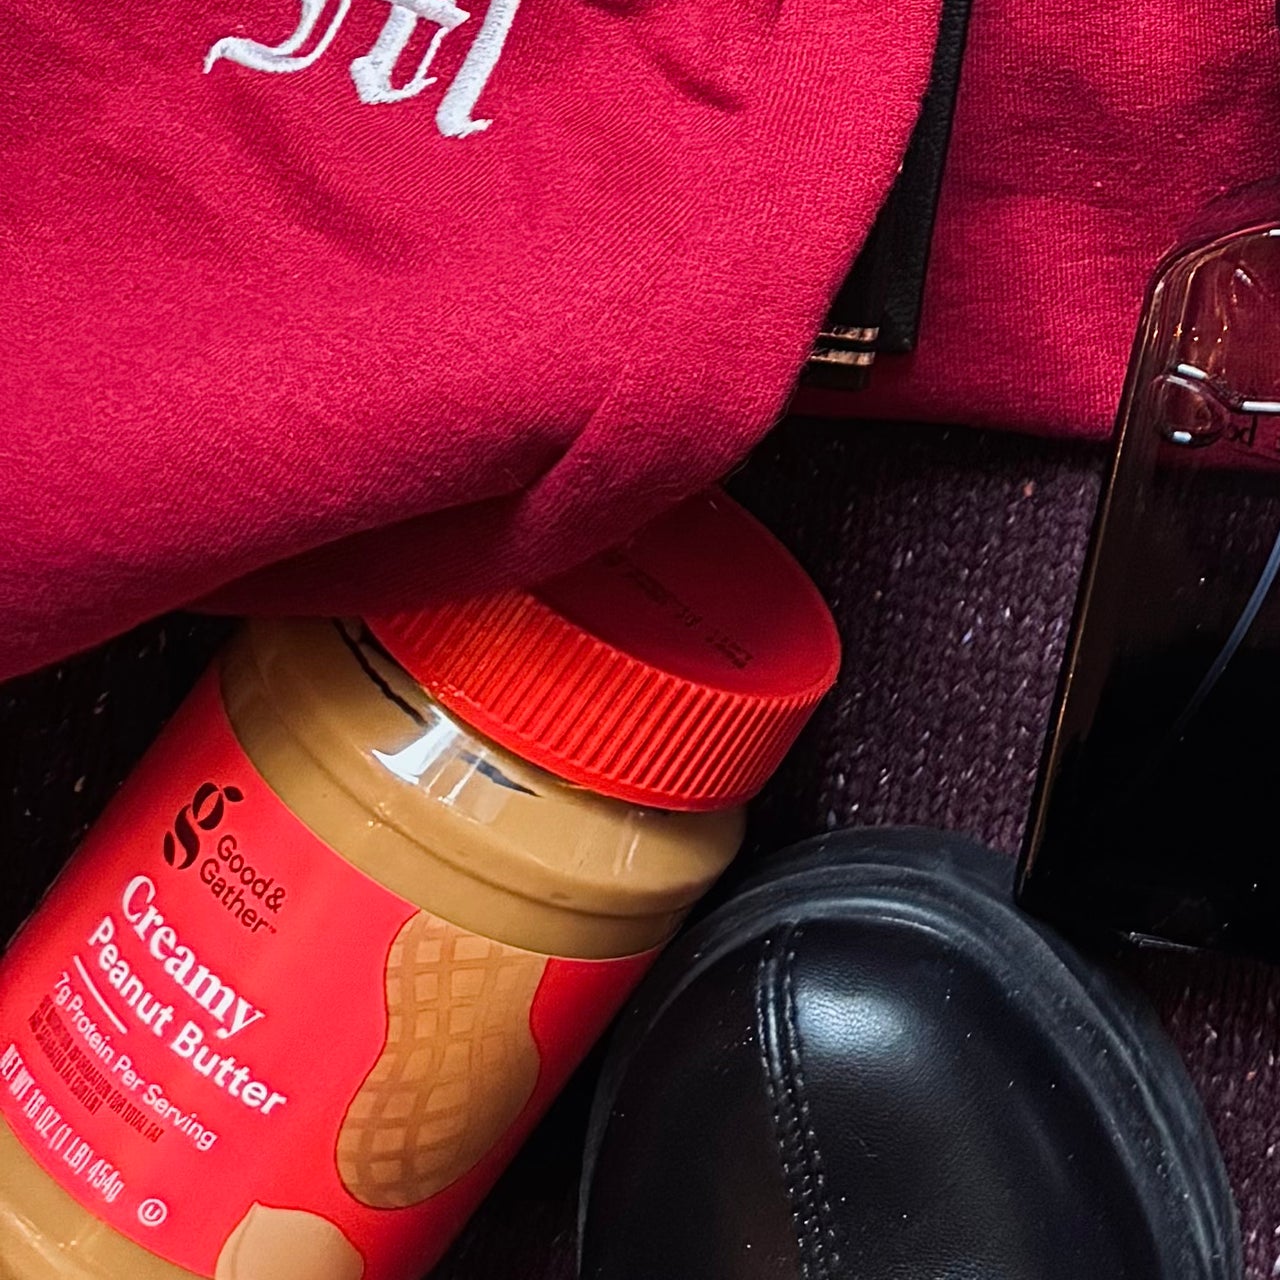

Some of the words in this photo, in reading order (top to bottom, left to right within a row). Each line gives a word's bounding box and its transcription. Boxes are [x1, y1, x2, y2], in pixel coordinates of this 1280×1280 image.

[121, 874, 266, 1040] Creamy
[87, 915, 175, 1038] Peanut
[169, 1019, 288, 1118] Butter
[65, 993, 116, 1065] Protein
[111, 1054, 146, 1092] Per
[142, 1083, 219, 1152] Serving
[22, 1088, 47, 1120] 16
[34, 1105, 62, 1138] OZ
[62, 1137, 95, 1176] LB)
[87, 1158, 125, 1204] 454g
